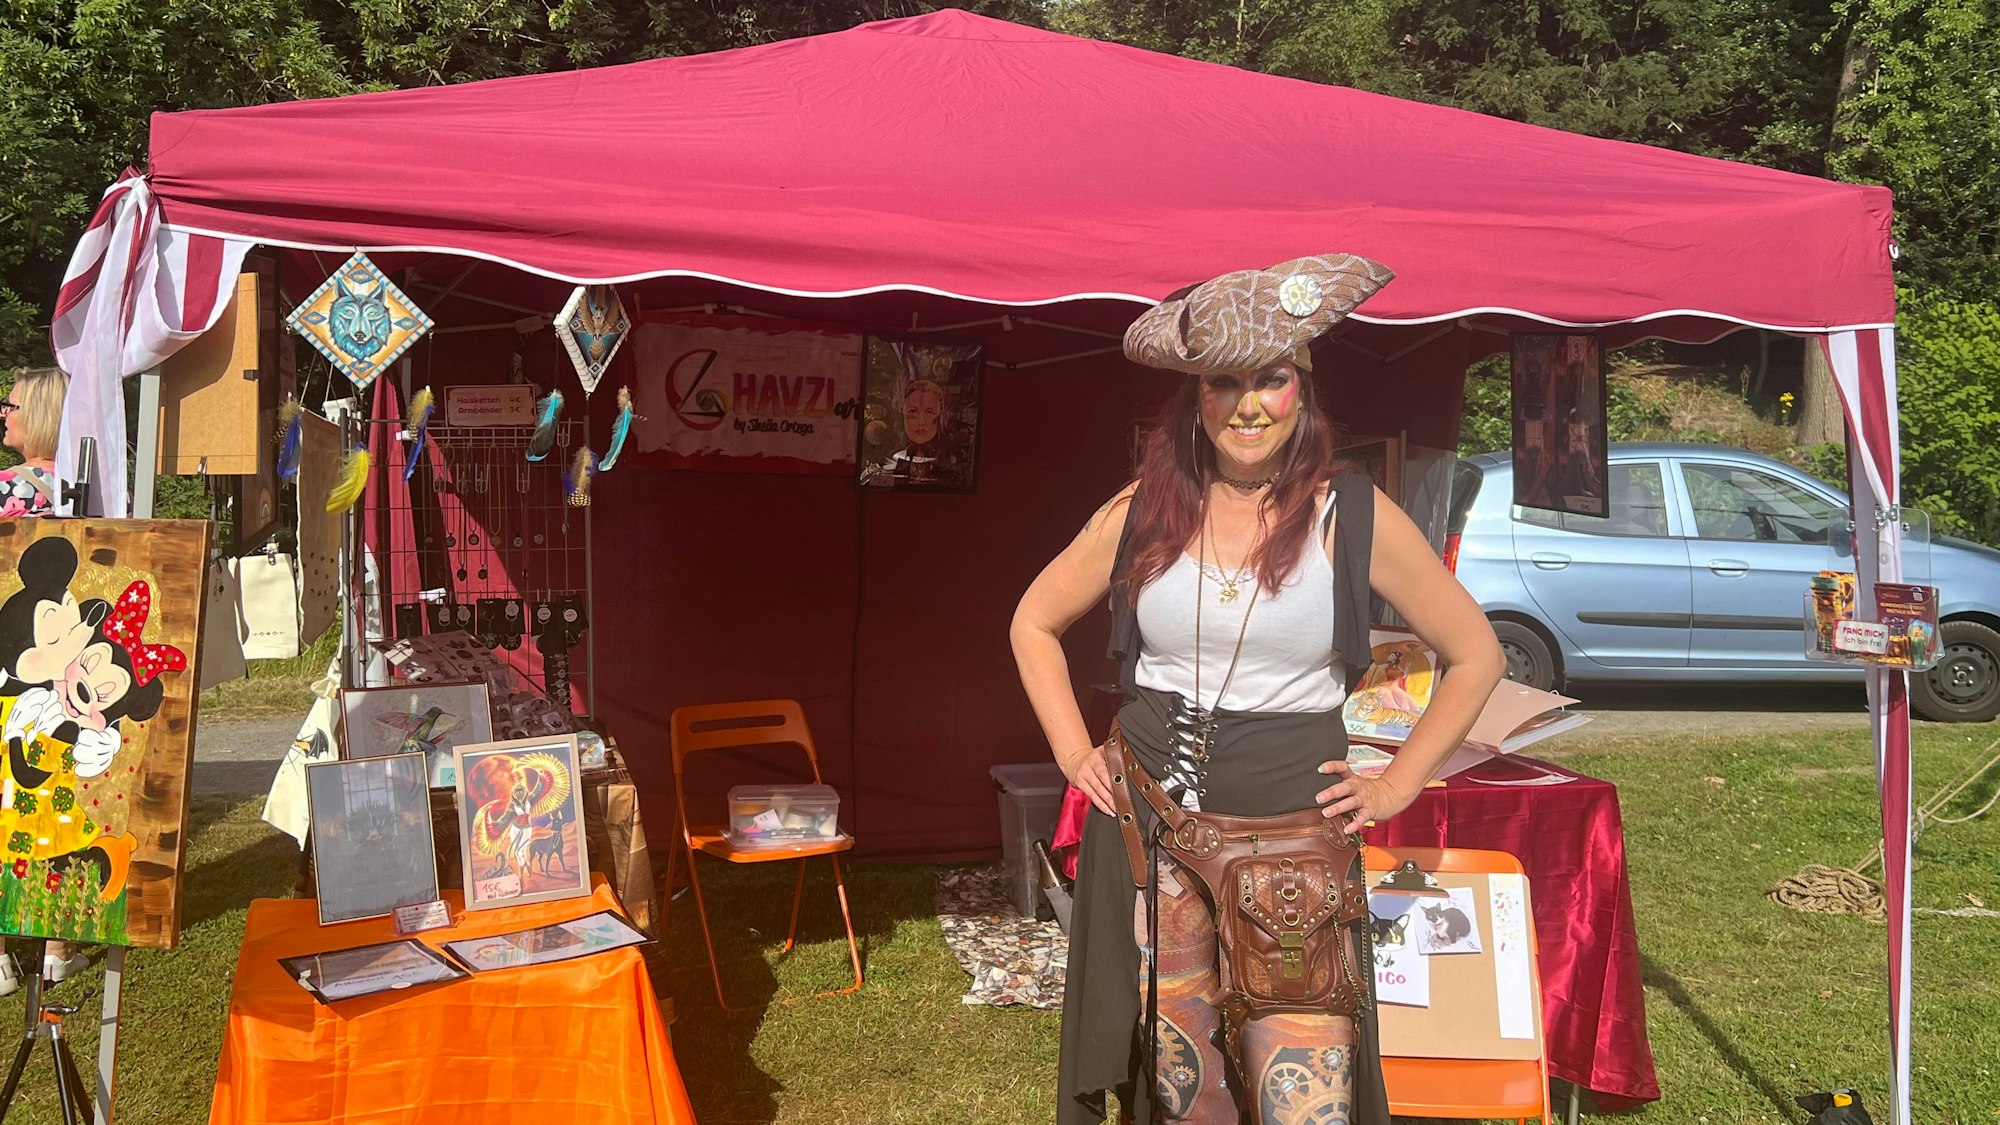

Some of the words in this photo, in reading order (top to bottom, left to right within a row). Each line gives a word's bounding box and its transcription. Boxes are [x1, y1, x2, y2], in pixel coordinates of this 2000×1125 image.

[456, 396, 500, 404] Halsketten
[732, 373, 835, 418] HAVZI
[734, 417, 746, 434] by
[748, 418, 779, 433] Sheila
[780, 420, 815, 436] Ortega
[1843, 626, 1863, 636] FANG
[1845, 636, 1856, 644] Ich
[1857, 638, 1869, 646] bin
[1870, 639, 1882, 647] frei
[482, 882, 500, 894] 15€
